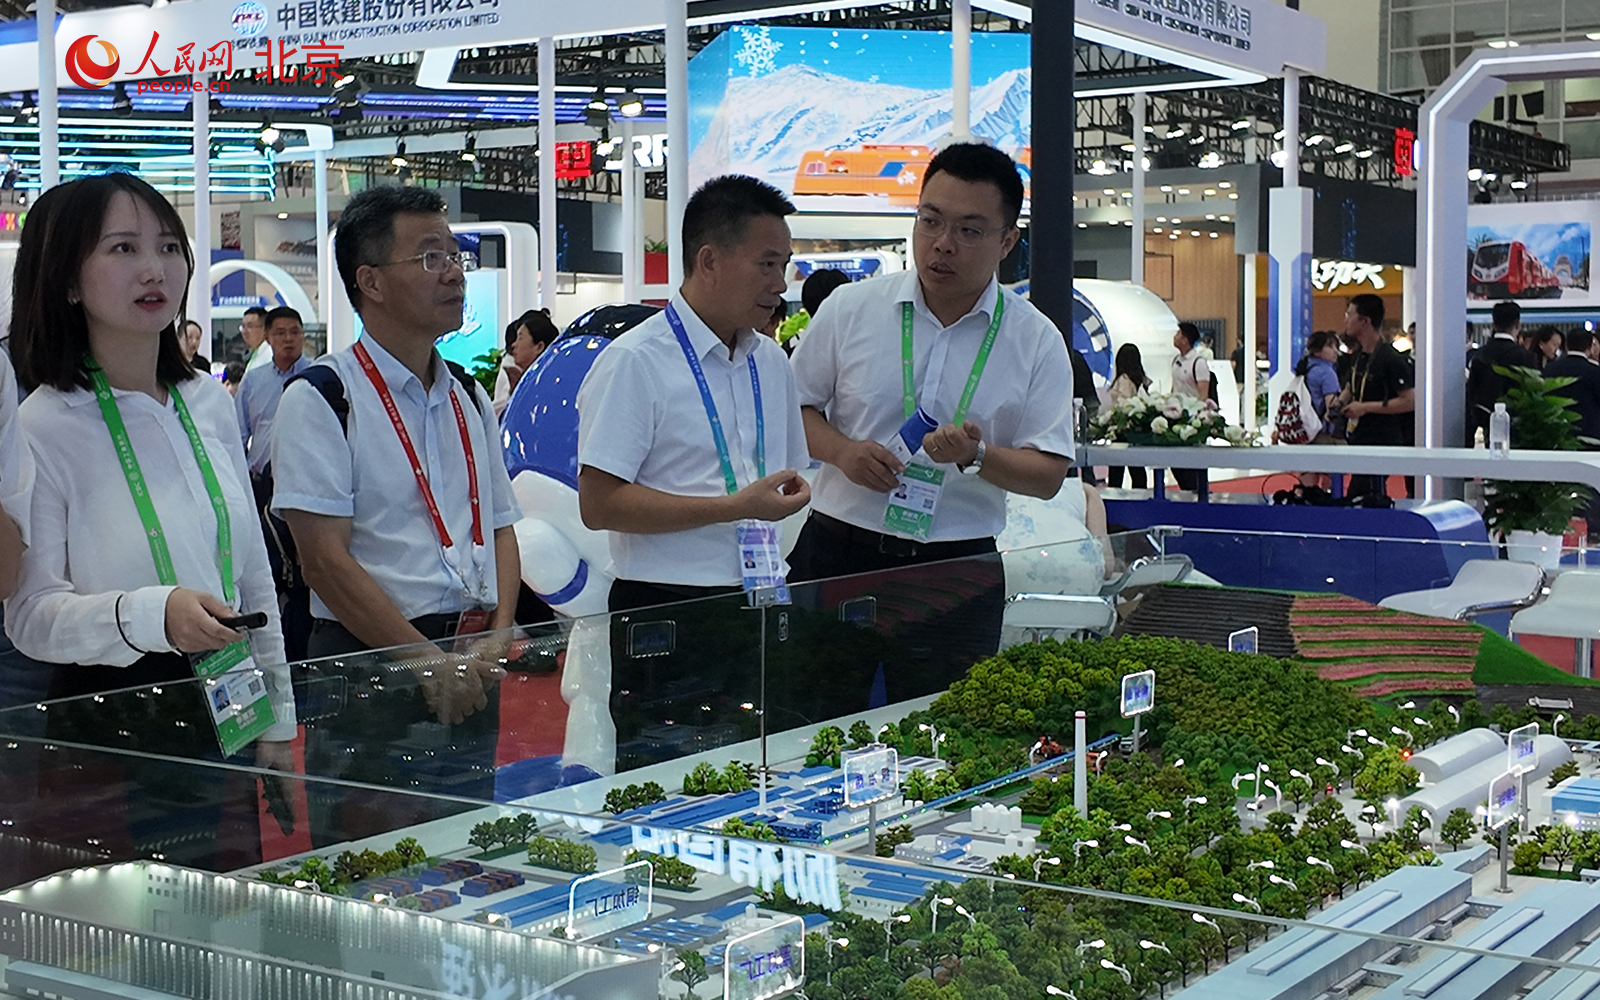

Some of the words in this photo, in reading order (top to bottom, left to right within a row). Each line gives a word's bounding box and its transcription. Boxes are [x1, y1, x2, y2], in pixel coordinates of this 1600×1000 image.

[277, 0, 499, 31] 中国铁建股份有限
